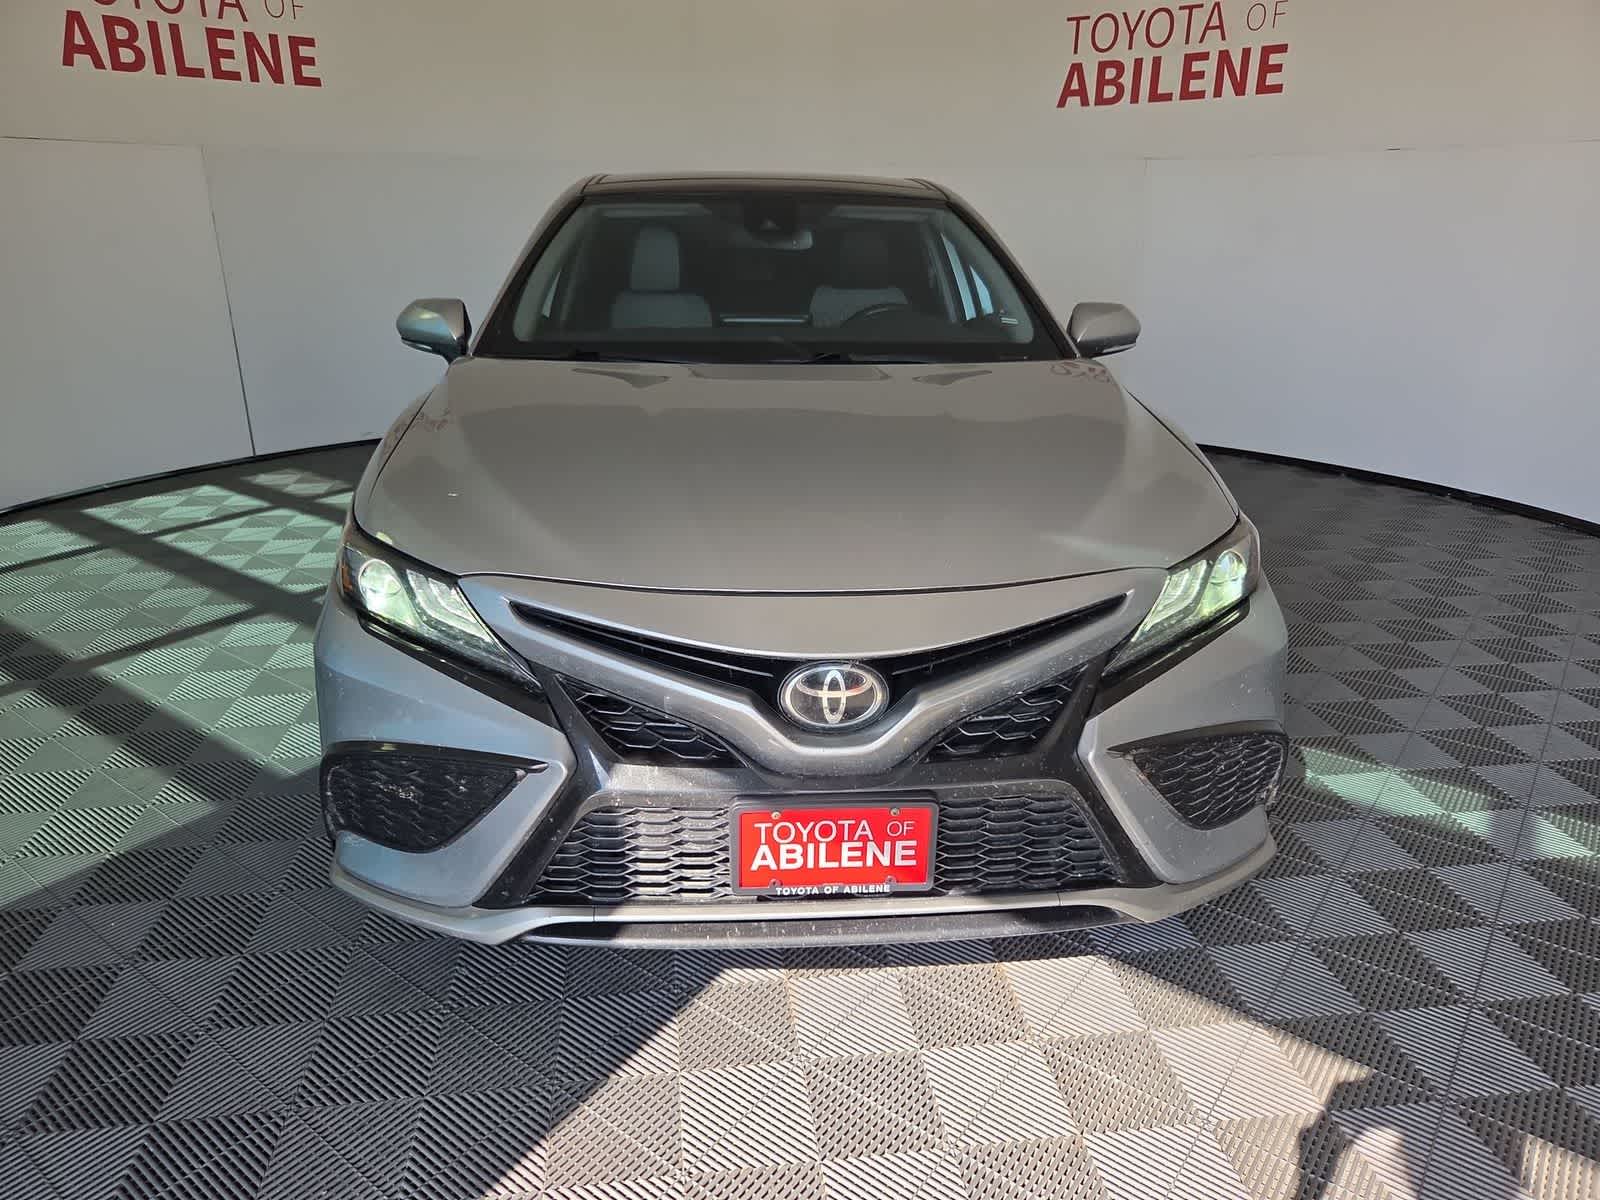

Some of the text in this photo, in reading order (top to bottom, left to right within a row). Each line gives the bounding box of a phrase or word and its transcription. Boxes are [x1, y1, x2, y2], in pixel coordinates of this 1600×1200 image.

[62, 9, 322, 87] ABILENE
[1066, 0, 1289, 55] TOYOTA OF
[1056, 43, 1289, 109] ABILENE
[753, 819, 915, 844] TOYOTA OF
[750, 840, 918, 871] ABILENE
[775, 884, 890, 896] TOYOTA OF ABILENE
